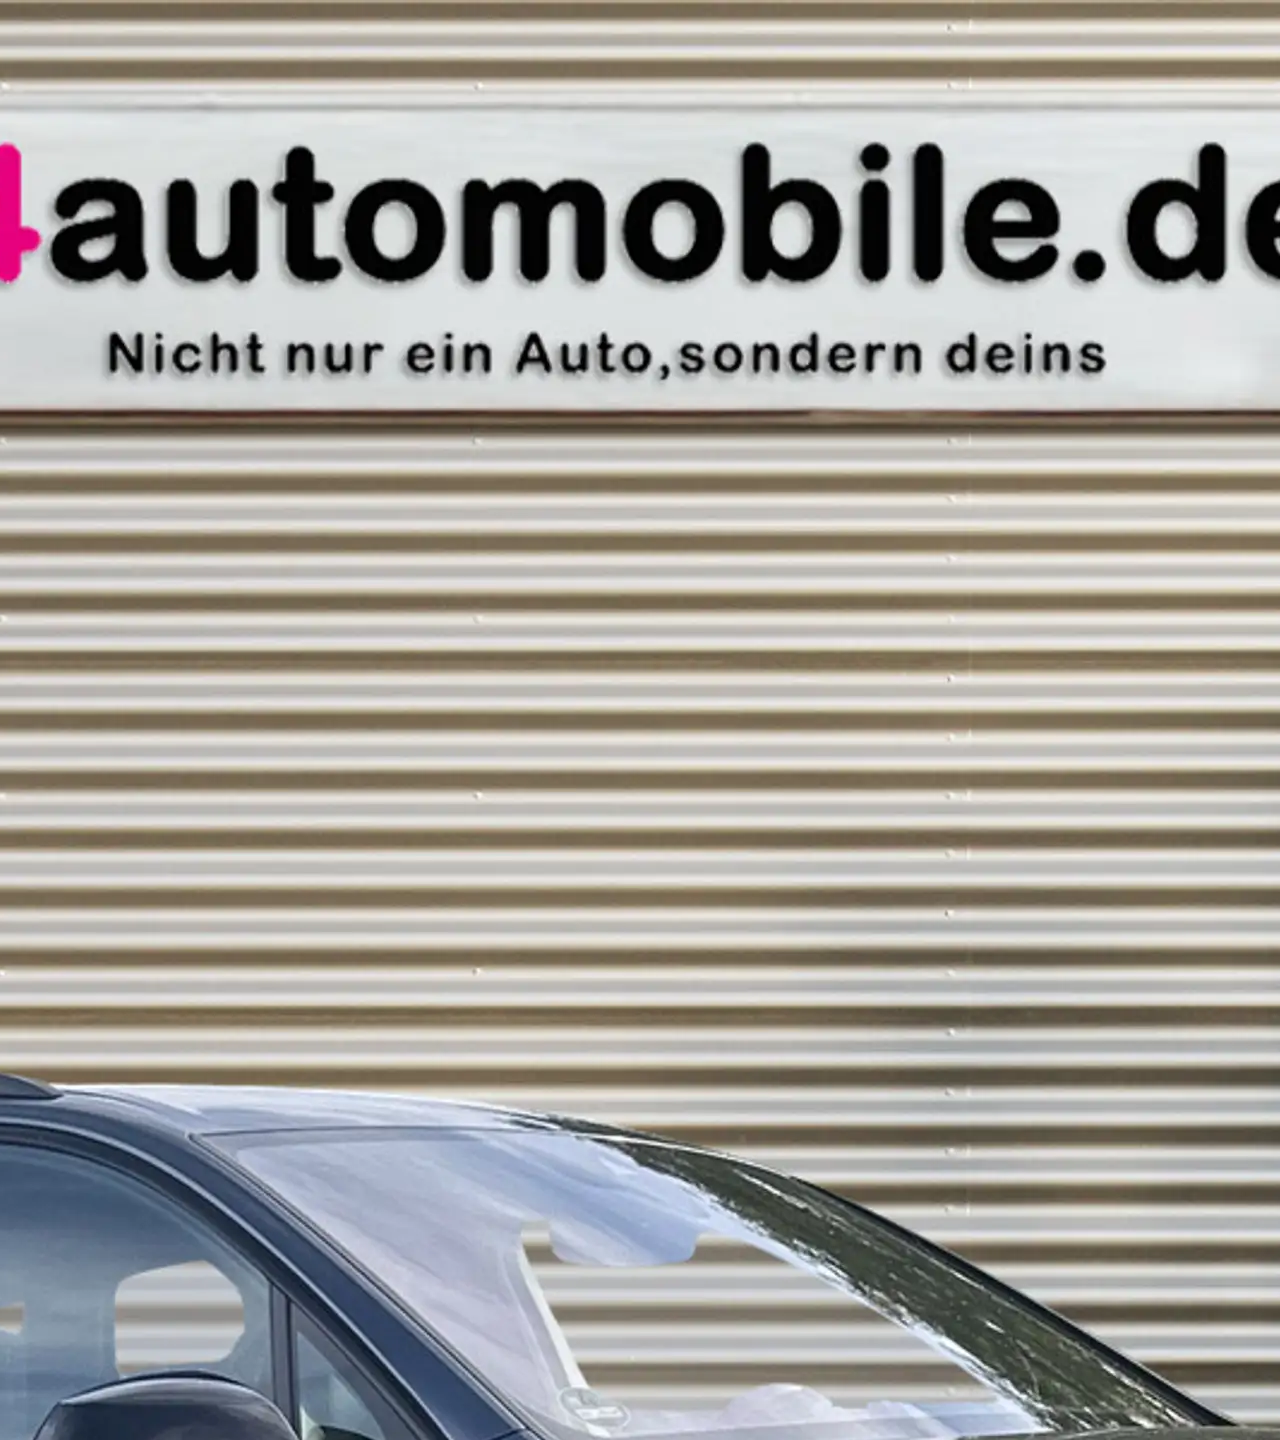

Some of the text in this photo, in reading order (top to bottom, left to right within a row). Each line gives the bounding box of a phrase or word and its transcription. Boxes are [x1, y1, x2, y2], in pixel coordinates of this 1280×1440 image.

[109, 333, 265, 374] Nicht
[287, 342, 384, 374] nur
[406, 332, 491, 374] ein
[945, 332, 1106, 374] deins
